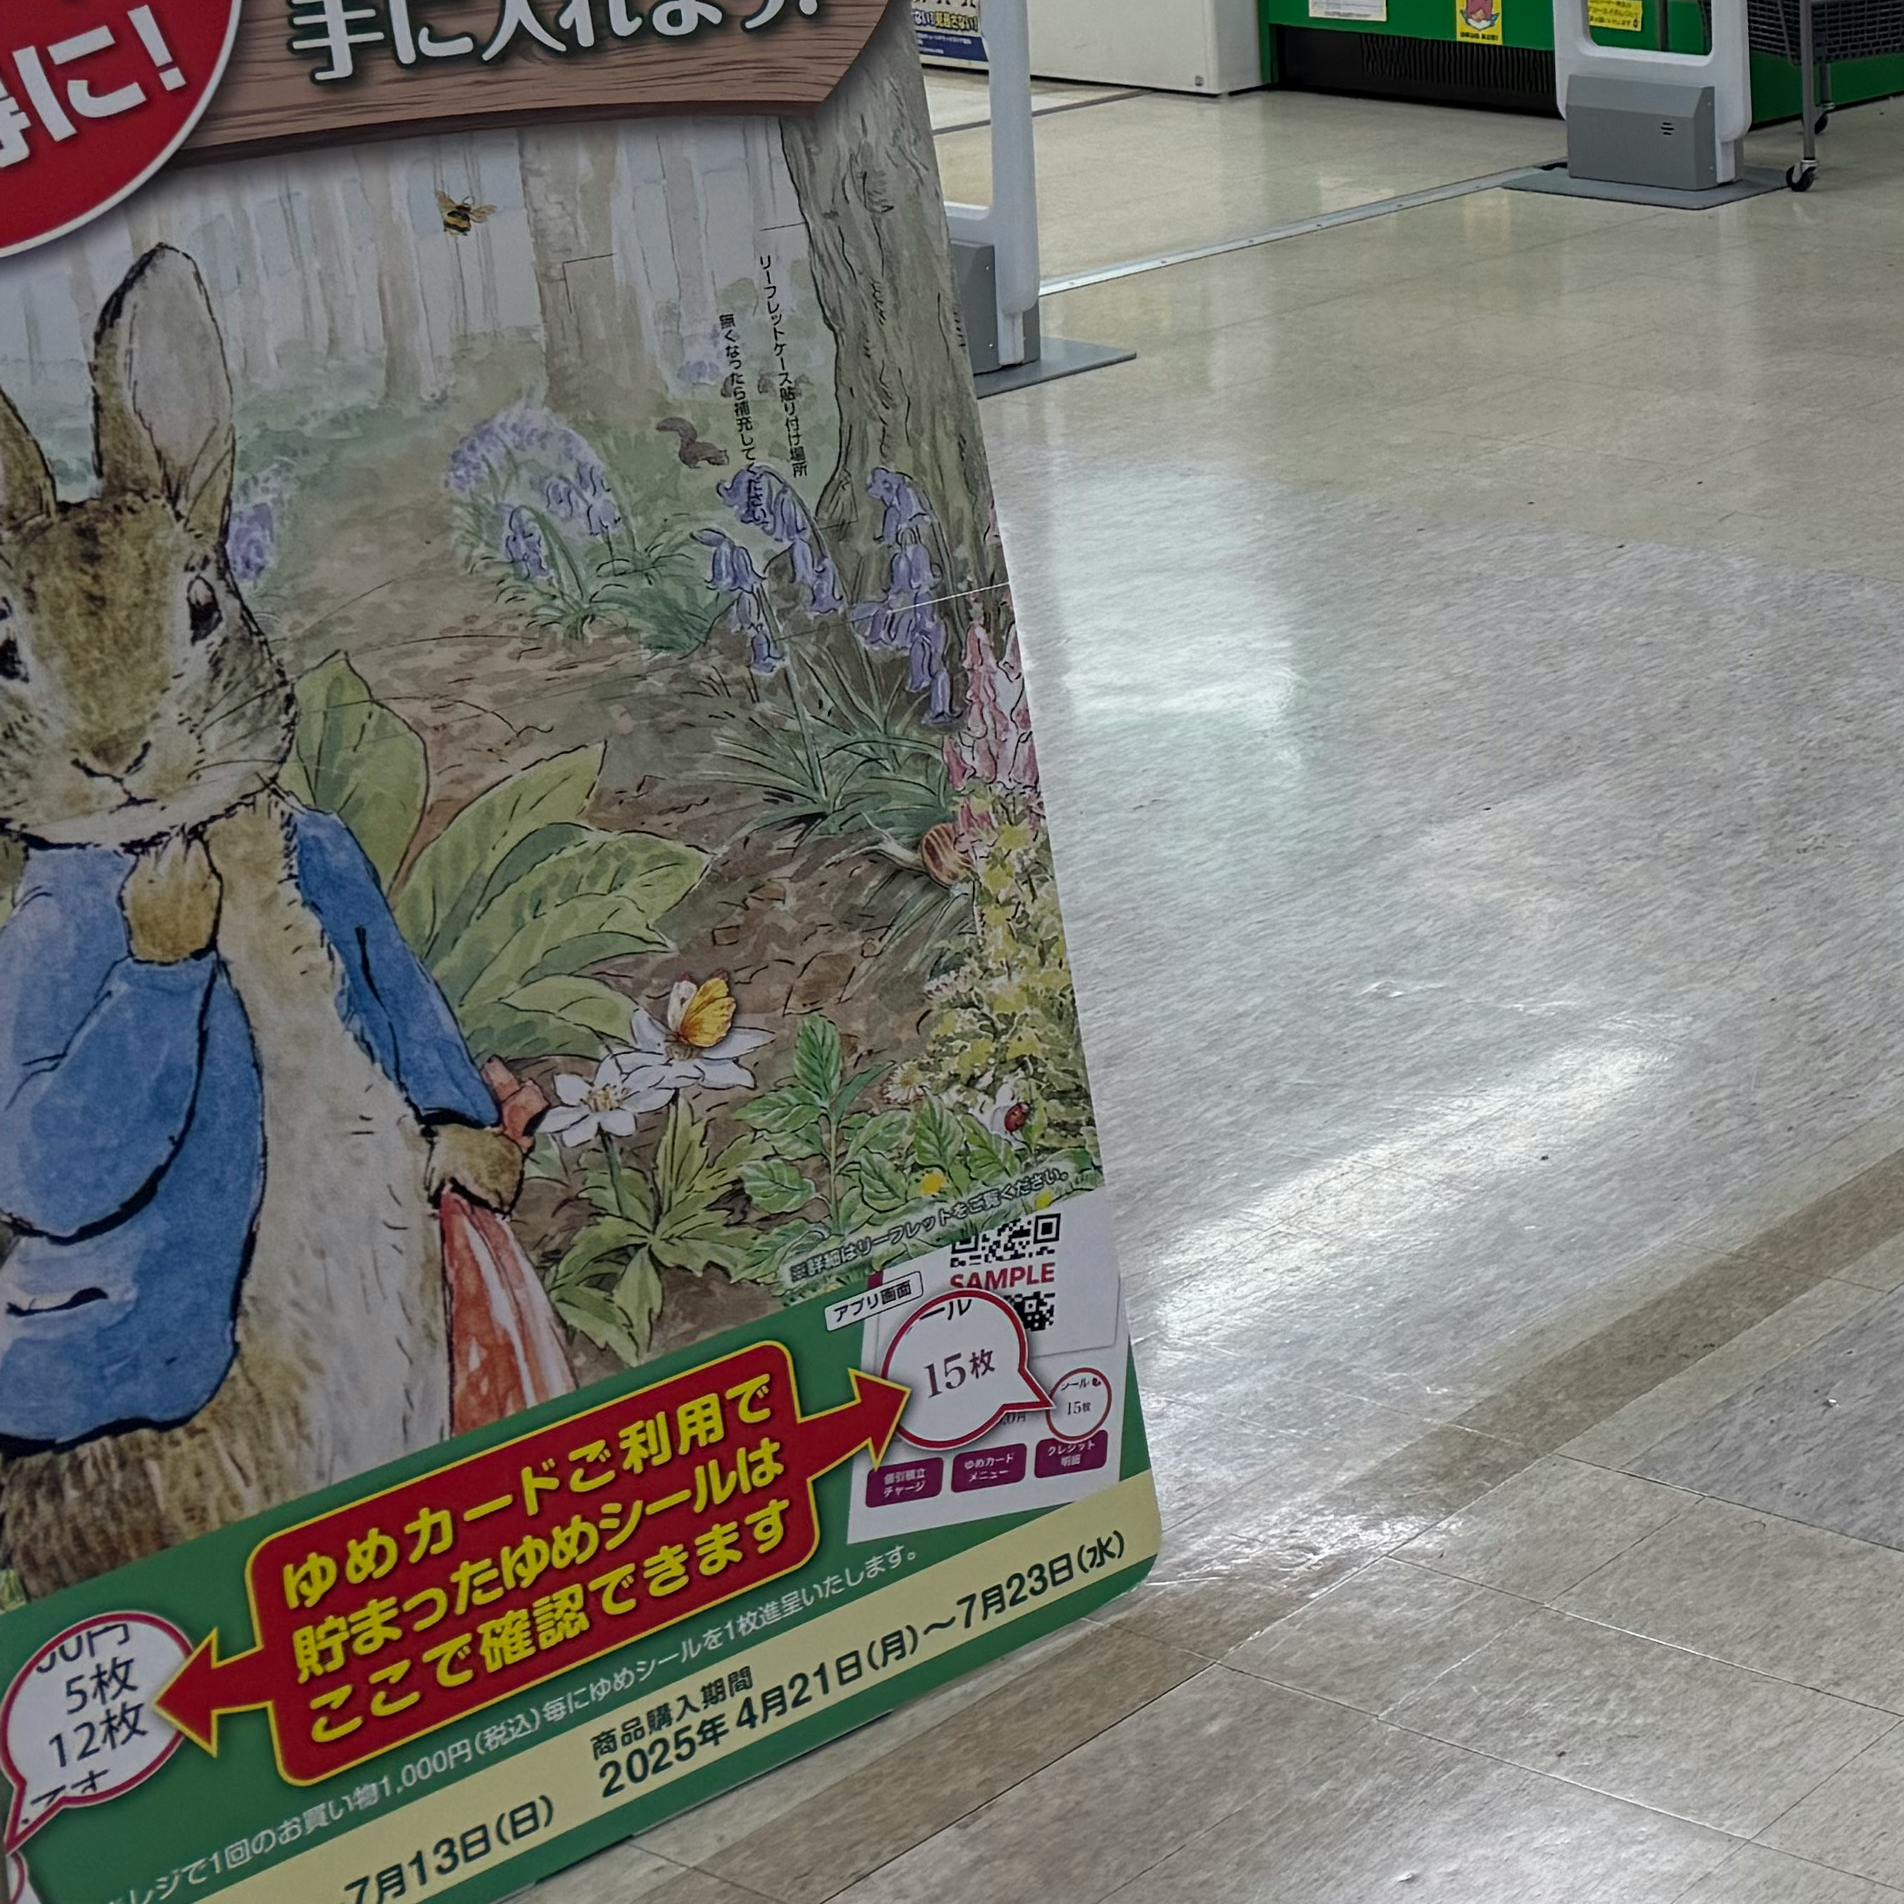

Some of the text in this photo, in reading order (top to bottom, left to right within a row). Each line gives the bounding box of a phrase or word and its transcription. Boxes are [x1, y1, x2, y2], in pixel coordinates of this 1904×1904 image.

[759, 254, 808, 478] リーフレットケース貼り付け場所
[833, 1279, 912, 1323] アプリ画面
[950, 1262, 1056, 1290] SAMPLE
[924, 1347, 997, 1399] 15枚
[281, 1371, 777, 1611] ゆめカードご利用で
[964, 1452, 1015, 1471] ゆめカード
[294, 1446, 785, 1687] 貯まったゆめシールは
[308, 1502, 791, 1746] ここで確認できます
[64, 1655, 140, 1718] 5枚
[591, 1664, 755, 1761] 商品購入期間
[48, 1700, 150, 1770] 12枚
[599, 1713, 729, 1799] 2025年
